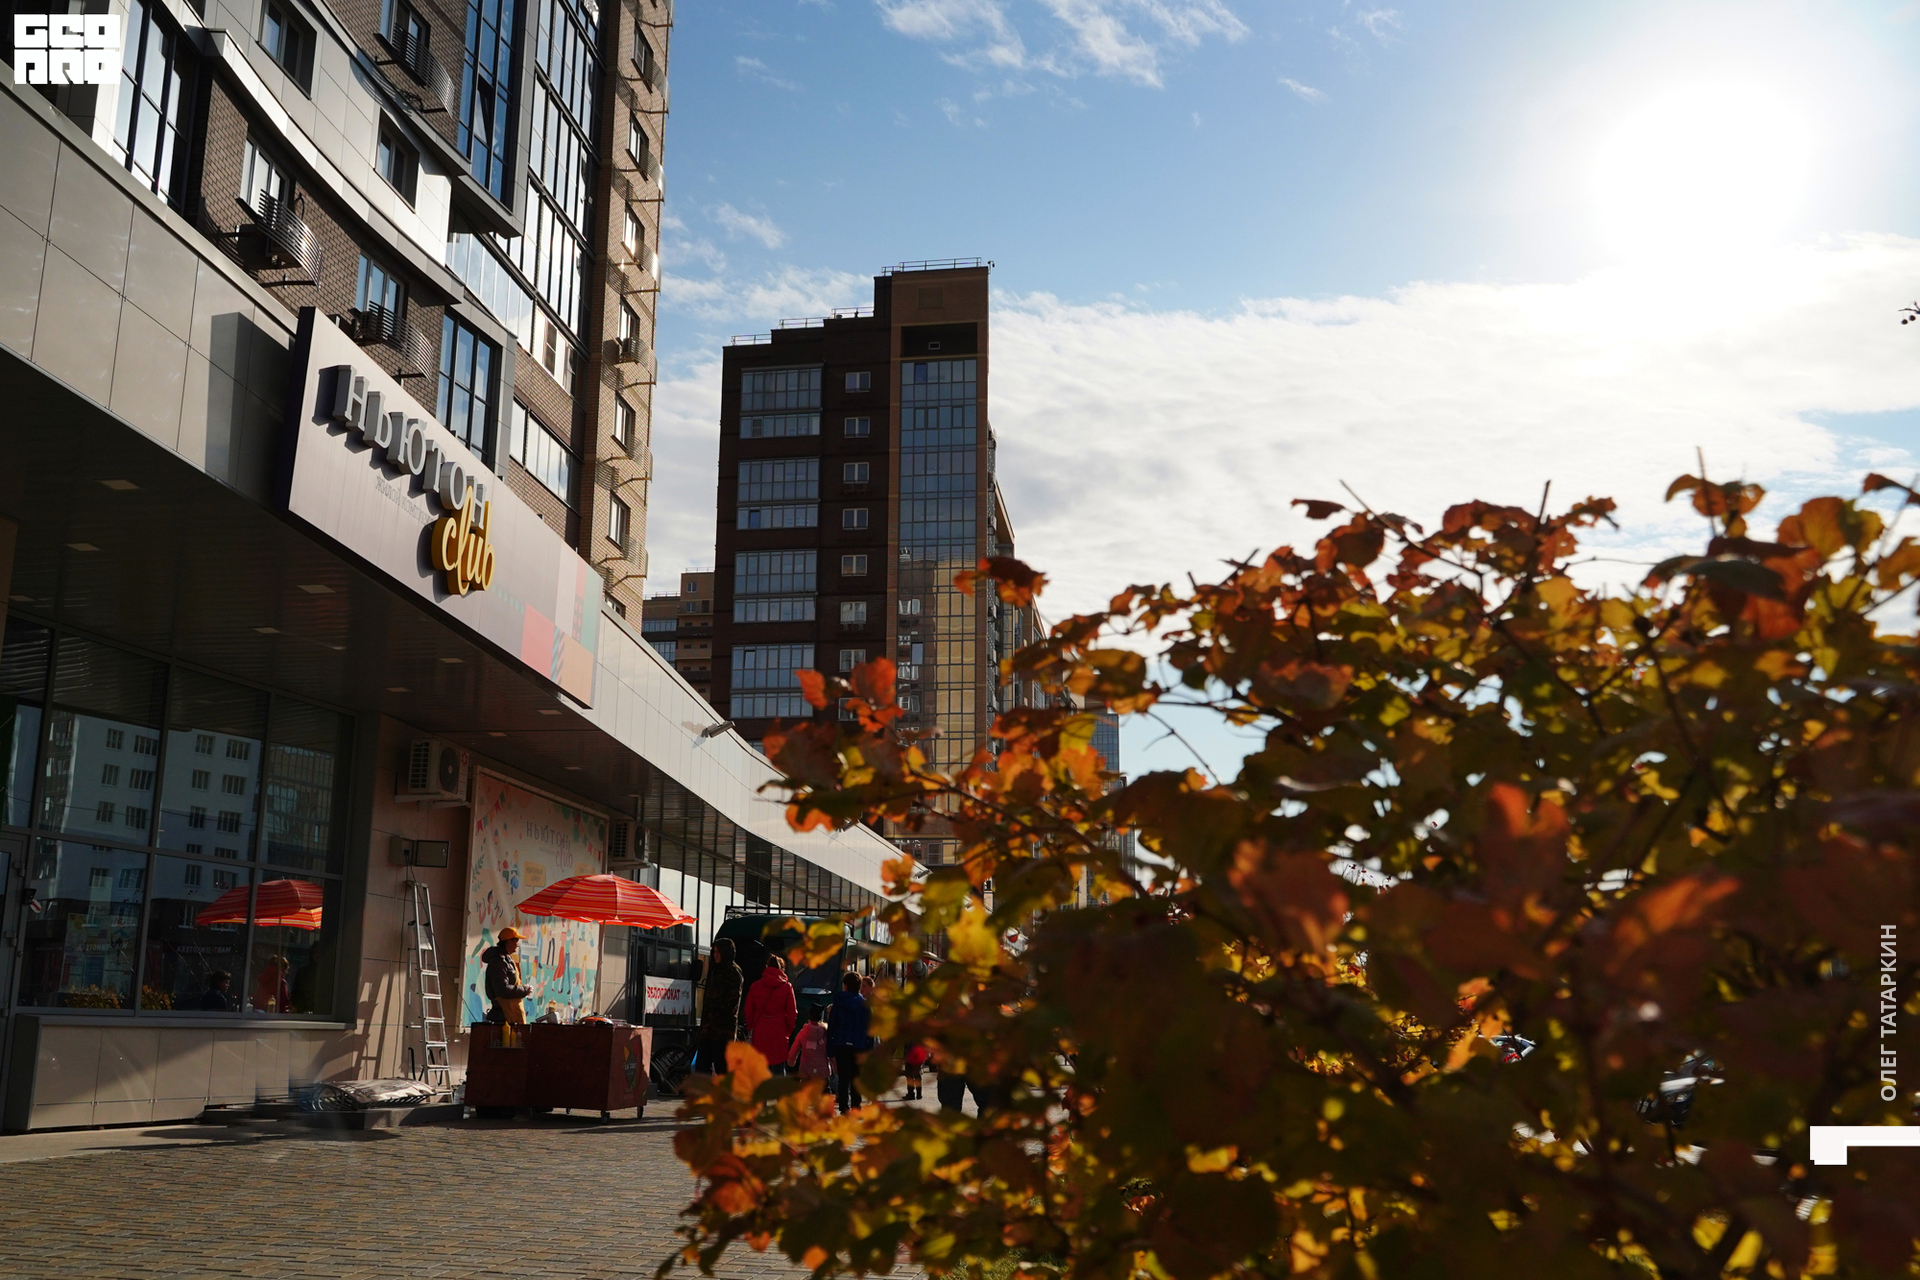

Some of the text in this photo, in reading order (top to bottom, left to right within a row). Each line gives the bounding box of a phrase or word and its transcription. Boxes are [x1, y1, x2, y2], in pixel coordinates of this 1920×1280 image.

[333, 365, 487, 528] НЬЮТОН
[432, 486, 494, 596] club
[526, 821, 569, 849] НЬЮТОН
[647, 986, 681, 1000] ВЕЛОПРОКАТ
